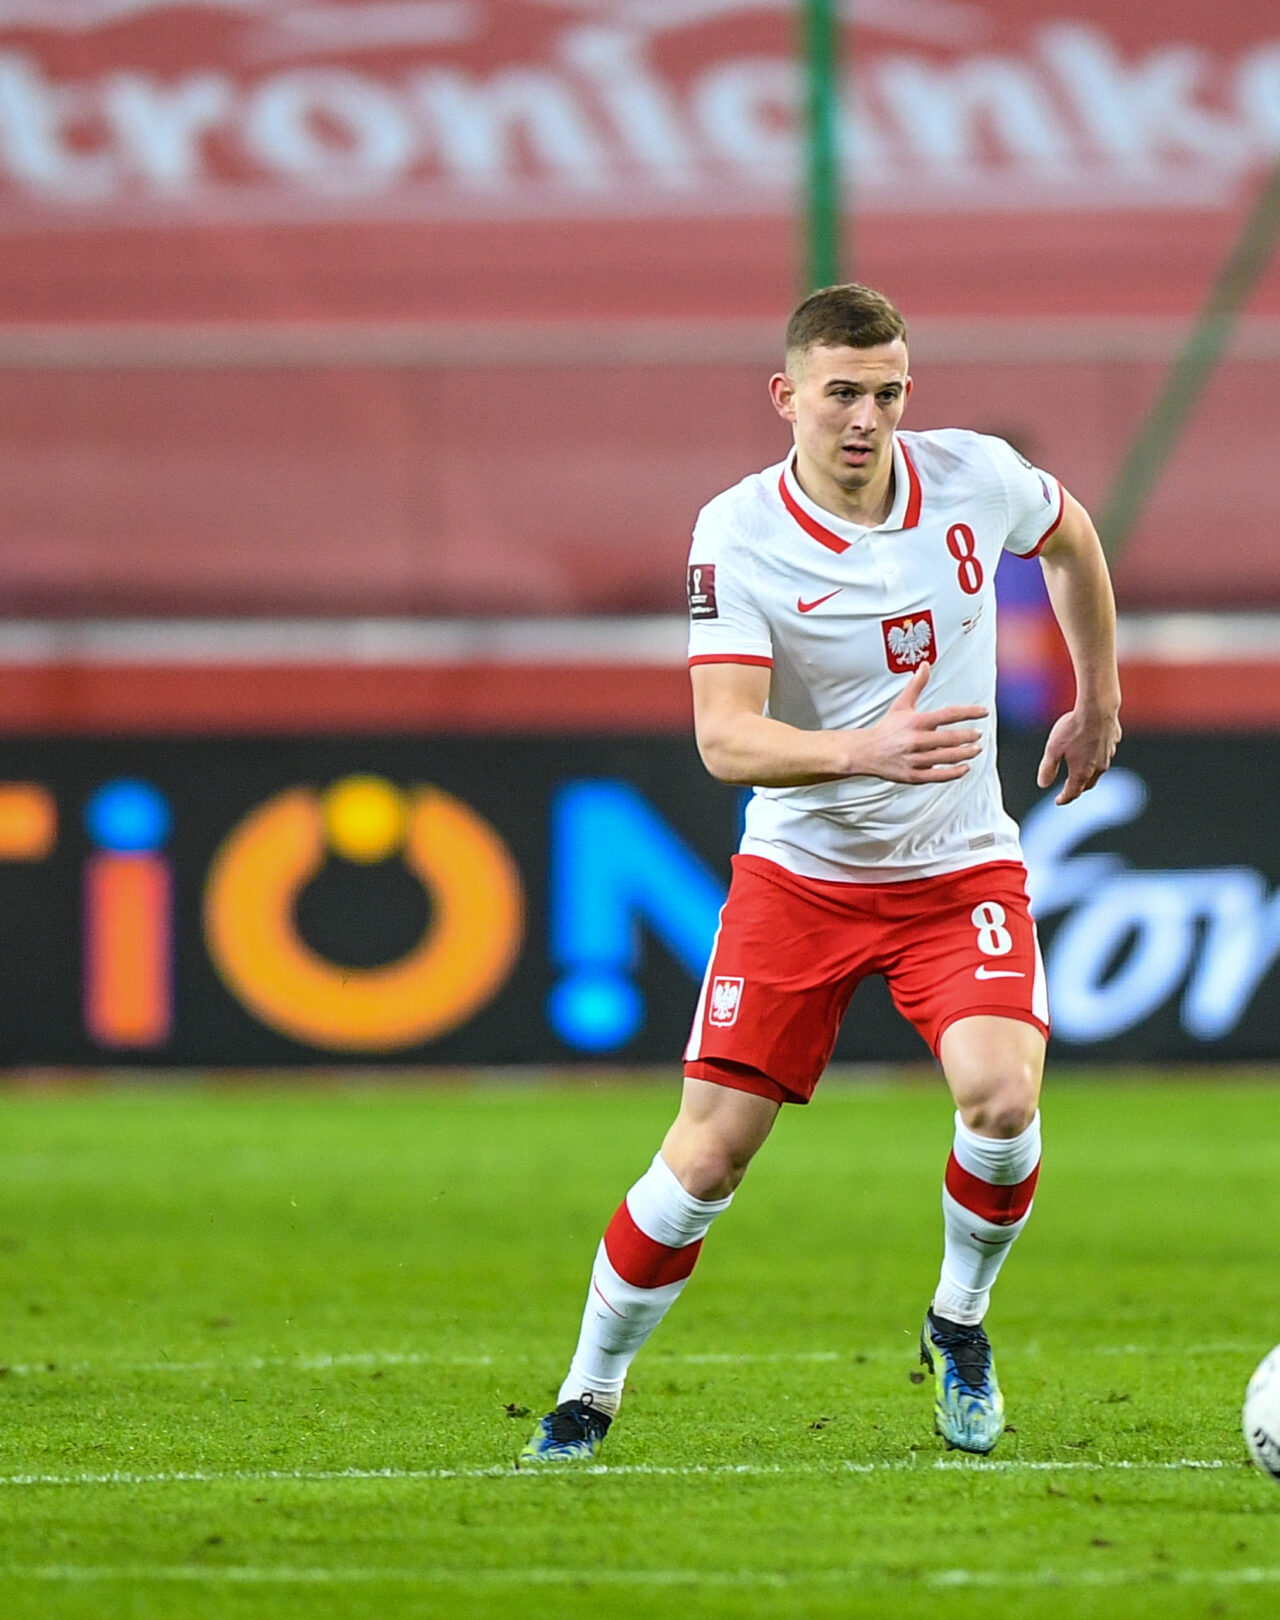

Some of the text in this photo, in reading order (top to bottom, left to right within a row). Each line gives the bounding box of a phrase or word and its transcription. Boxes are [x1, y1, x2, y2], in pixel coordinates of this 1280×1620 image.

[945, 521, 984, 596] 8
[0, 773, 757, 1053] iON
[970, 901, 1013, 956] 8
